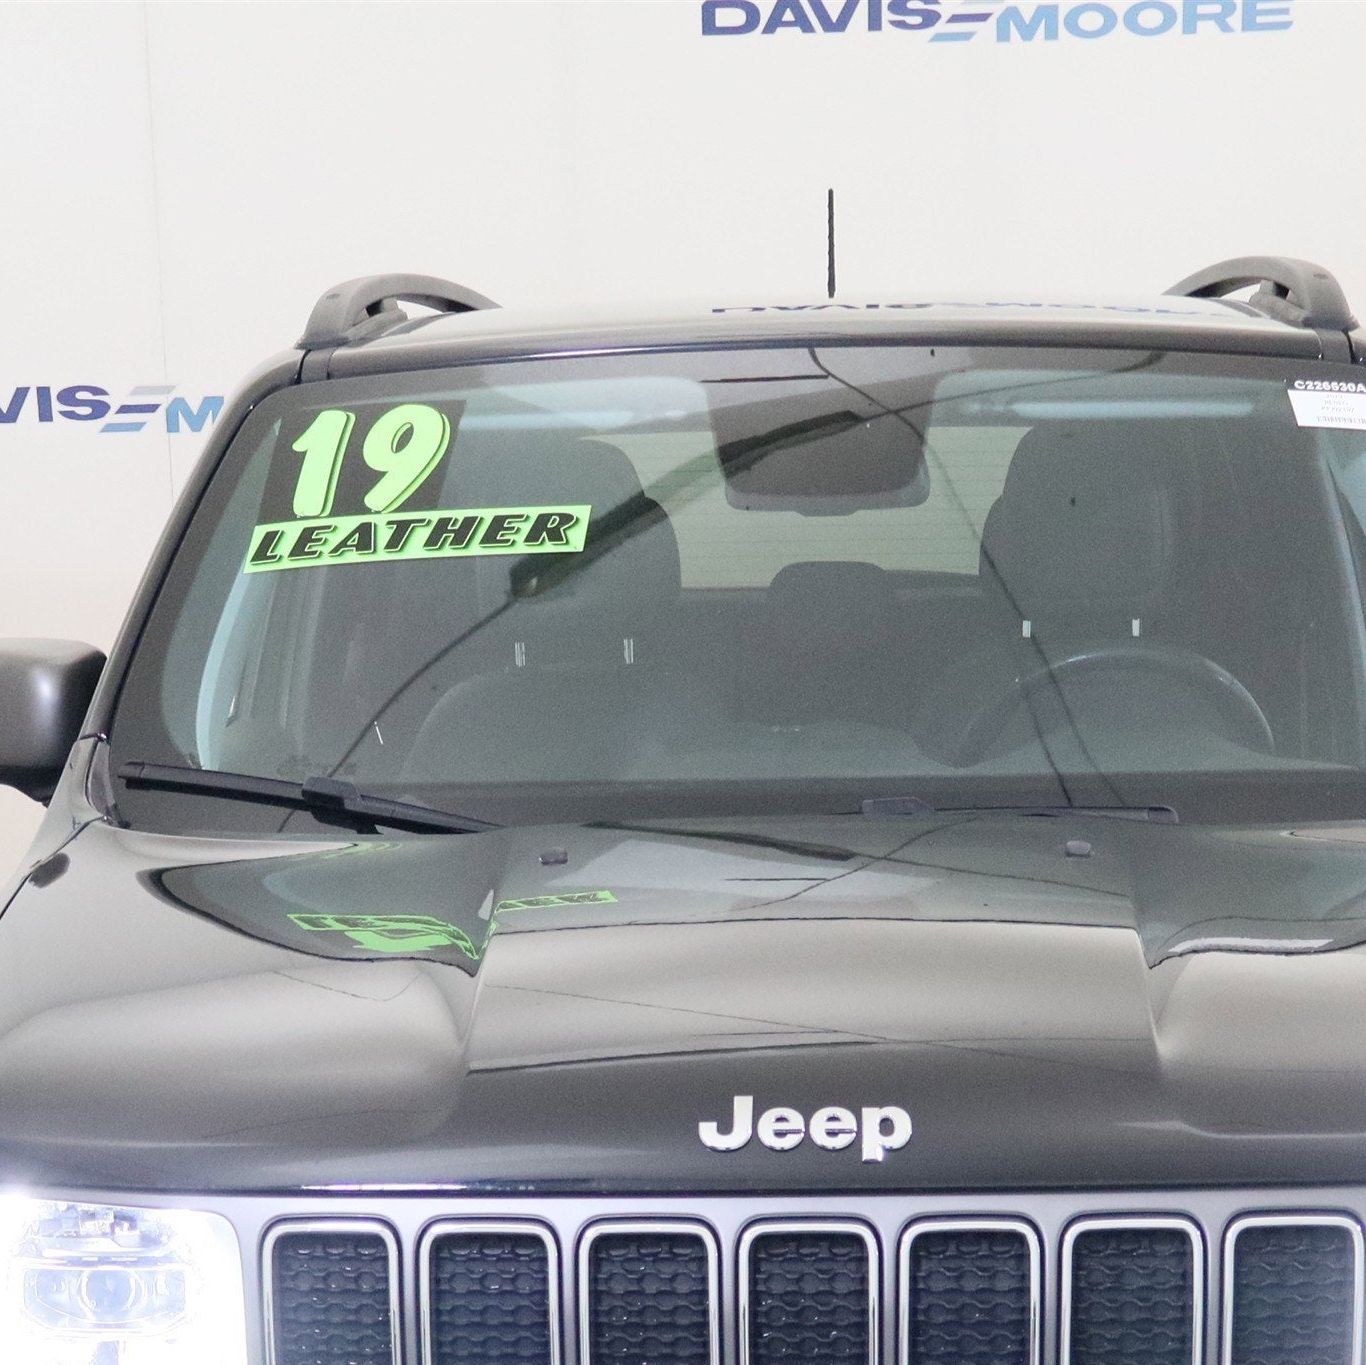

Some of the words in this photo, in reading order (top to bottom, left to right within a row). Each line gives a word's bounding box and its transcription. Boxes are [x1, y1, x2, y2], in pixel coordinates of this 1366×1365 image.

[291, 403, 452, 519] 19
[247, 510, 585, 565] LEATHER
[698, 1095, 913, 1164] Jeep
